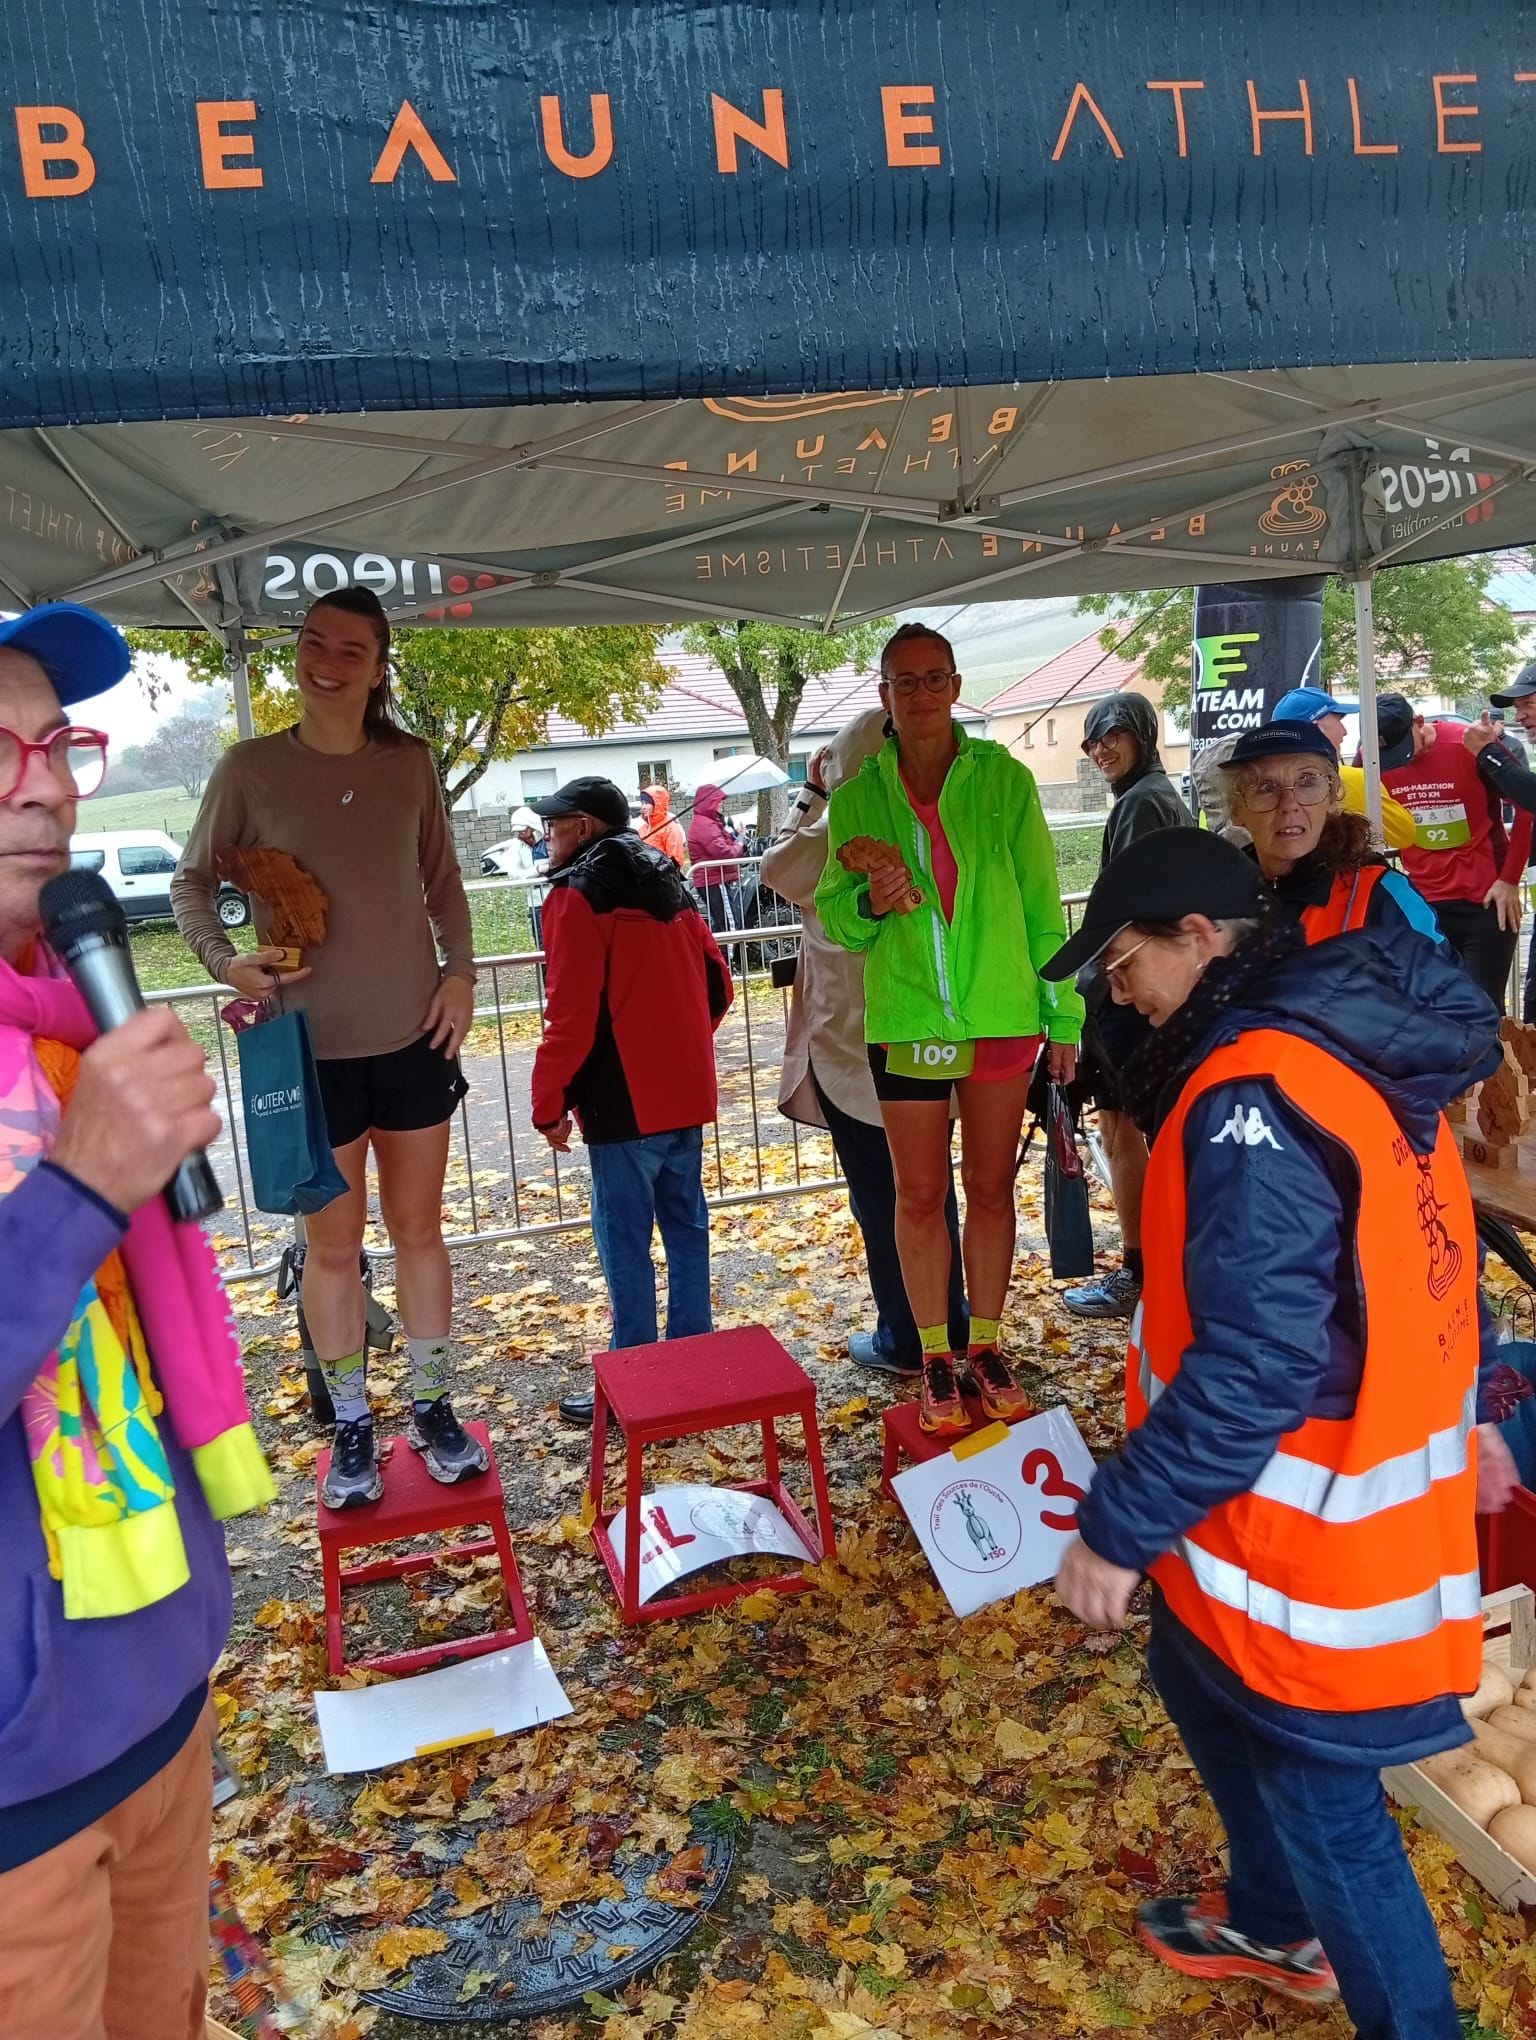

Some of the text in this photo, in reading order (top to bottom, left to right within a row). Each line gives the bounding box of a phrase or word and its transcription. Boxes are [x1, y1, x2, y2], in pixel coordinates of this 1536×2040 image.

[15, 73, 1536, 198] BEAUNE ATHLE
[1211, 713, 1262, 730] .COM
[1391, 782, 1455, 795] SEMI-MARATHON
[1426, 829, 1449, 842] 92
[912, 1043, 958, 1065] 109
[1021, 1448, 1088, 1531] 3
[988, 1547, 1006, 1560] TSO
